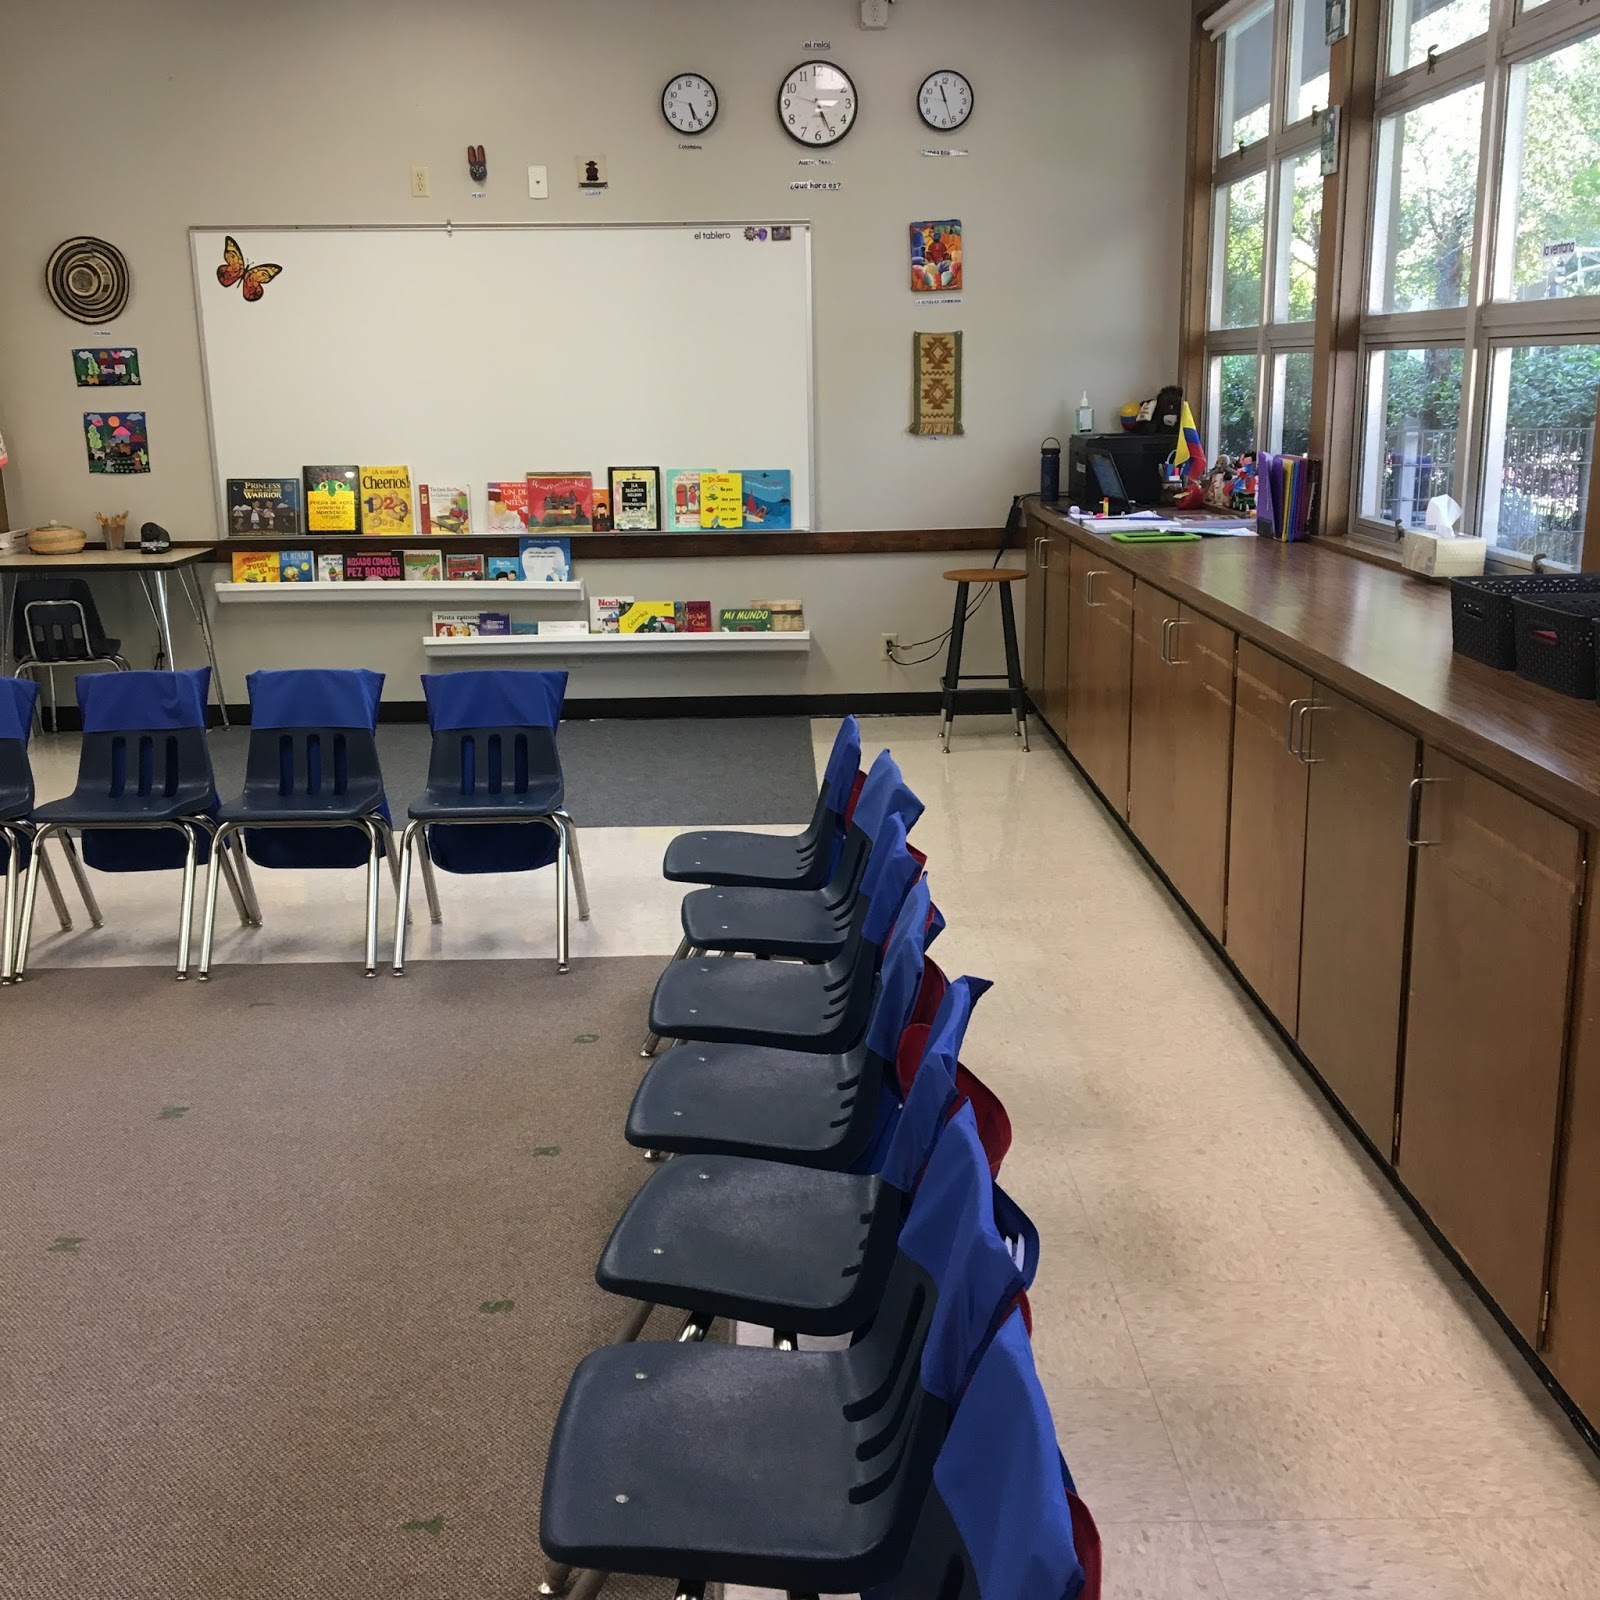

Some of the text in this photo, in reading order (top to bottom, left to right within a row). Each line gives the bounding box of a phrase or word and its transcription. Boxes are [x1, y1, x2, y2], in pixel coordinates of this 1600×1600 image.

[804, 40, 812, 48] el
[799, 71, 807, 82] 11
[812, 65, 824, 77] 12
[786, 82, 797, 94] 10
[783, 98, 791, 110] 9
[845, 98, 852, 109] 3
[788, 114, 796, 125] 8
[840, 114, 847, 124] 4
[800, 126, 807, 137] 7
[814, 130, 822, 141] 6
[829, 126, 836, 137] 5
[810, 181, 827, 189] hora
[694, 231, 731, 240] el tablero
[1543, 241, 1575, 257] la ventana
[244, 481, 281, 489] PRINCESS
[362, 474, 410, 490] Cheerios!
[243, 491, 282, 499] WARRIOR
[502, 488, 515, 496] UN
[383, 496, 394, 509] 2
[247, 562, 268, 570] JUEGA
[347, 557, 371, 566] ROSADO
[372, 557, 391, 566] COMO
[392, 557, 400, 566] EL
[347, 565, 400, 577] PEZ BORRÓN
[723, 610, 768, 620] MI MUNDO
